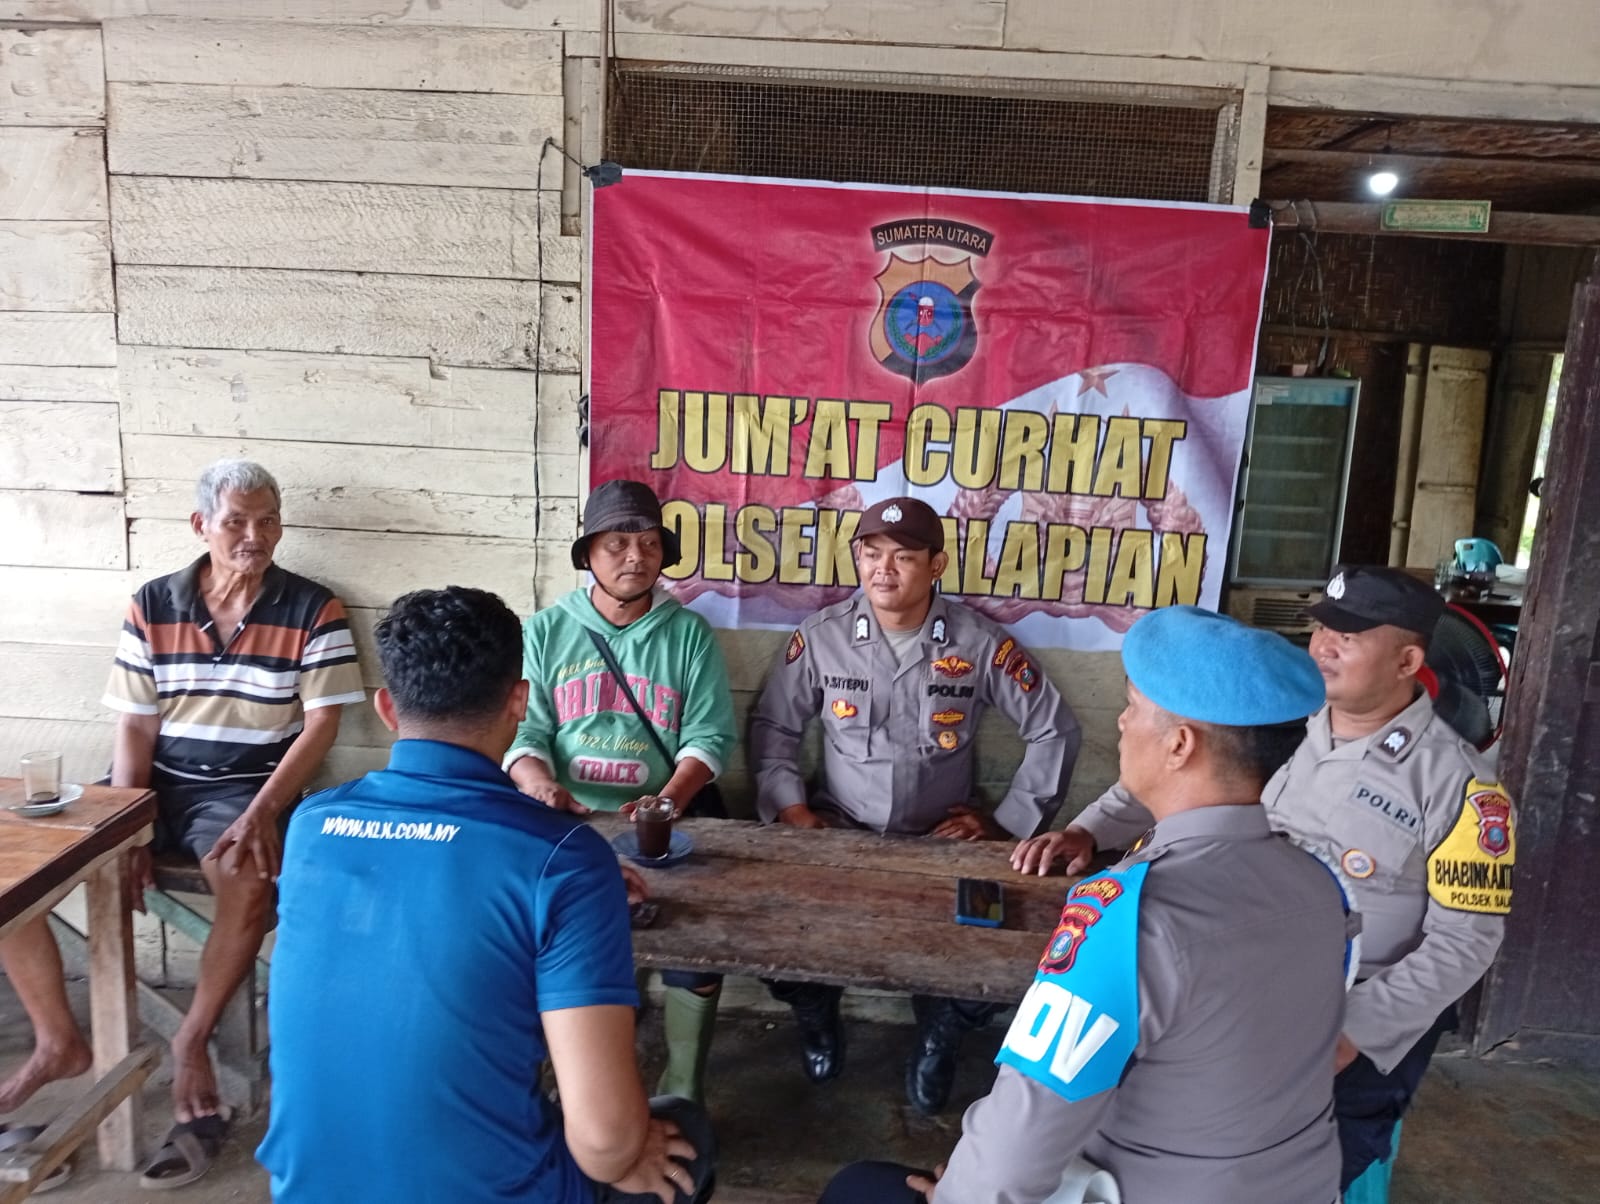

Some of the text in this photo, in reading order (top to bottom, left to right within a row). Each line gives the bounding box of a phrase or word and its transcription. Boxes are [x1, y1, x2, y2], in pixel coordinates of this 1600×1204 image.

[876, 224, 987, 252] SUMATERA UTARA
[650, 389, 1187, 500] JUM'AT CURHAT
[660, 499, 863, 588] OLSEK
[927, 684, 975, 699] POLRI
[579, 759, 641, 785] TRACK
[1356, 787, 1418, 828] POLRI
[1451, 891, 1490, 908] POLSEK
[999, 977, 1120, 1084] OV
